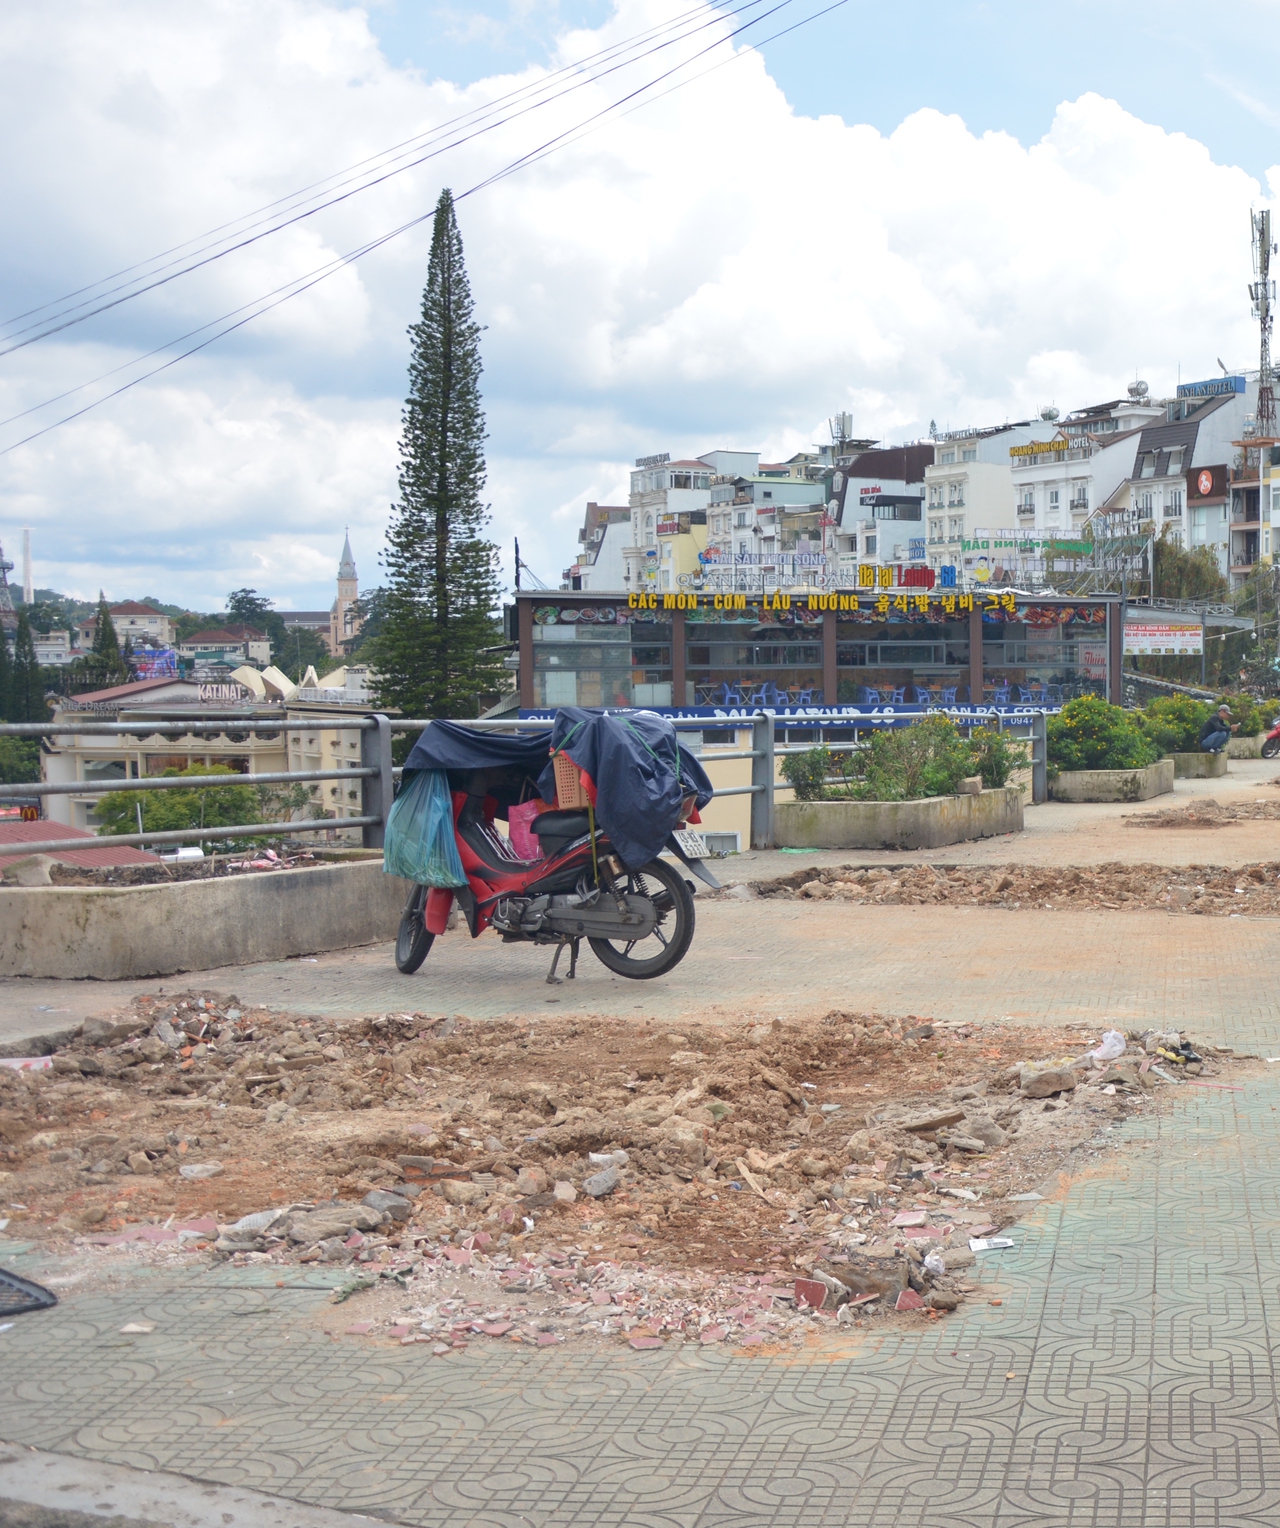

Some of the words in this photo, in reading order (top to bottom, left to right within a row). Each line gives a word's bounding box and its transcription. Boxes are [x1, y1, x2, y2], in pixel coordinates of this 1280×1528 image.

[1207, 380, 1233, 396] HOTEL
[1032, 441, 1051, 455] MINH
[1068, 435, 1089, 449] HOTEL
[940, 564, 956, 588] 68
[628, 590, 658, 610] CÁC
[663, 590, 698, 610] MÓN
[713, 593, 747, 610] CƠM
[763, 588, 791, 610] LẨU
[808, 591, 859, 611] NƯỚNG
[198, 684, 242, 700] KATINAT
